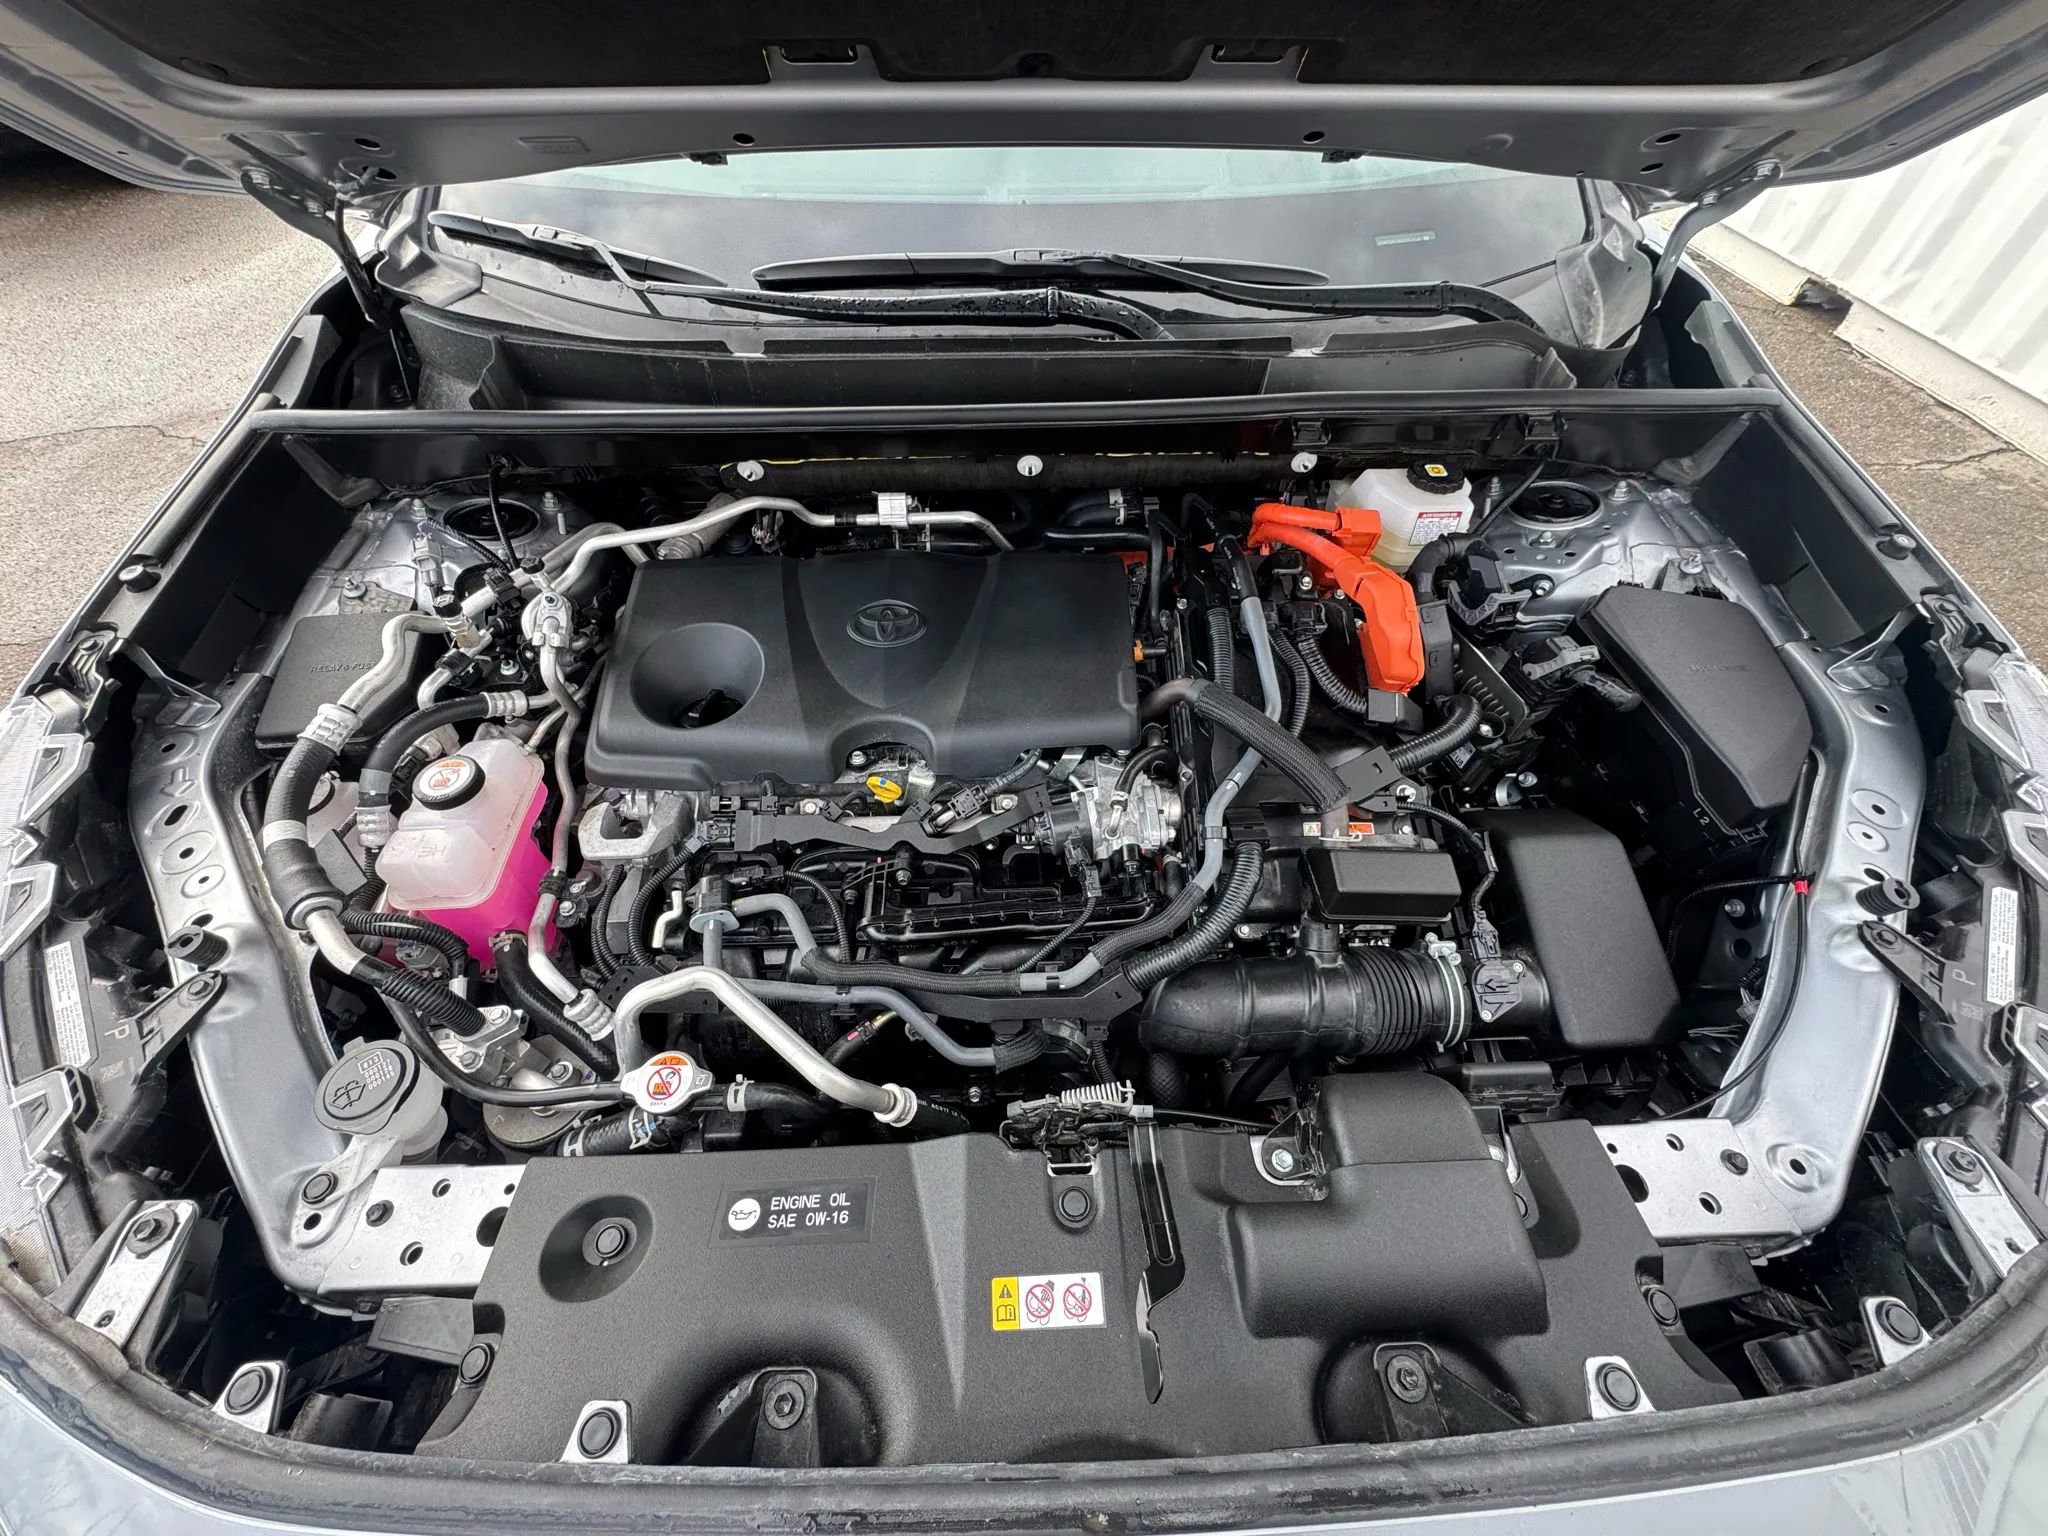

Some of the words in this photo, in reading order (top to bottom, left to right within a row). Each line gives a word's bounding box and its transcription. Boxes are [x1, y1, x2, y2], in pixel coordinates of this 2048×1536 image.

[770, 1194, 821, 1211] ENGINE
[829, 1192, 851, 1207] OIL
[767, 1213, 797, 1229] SAE
